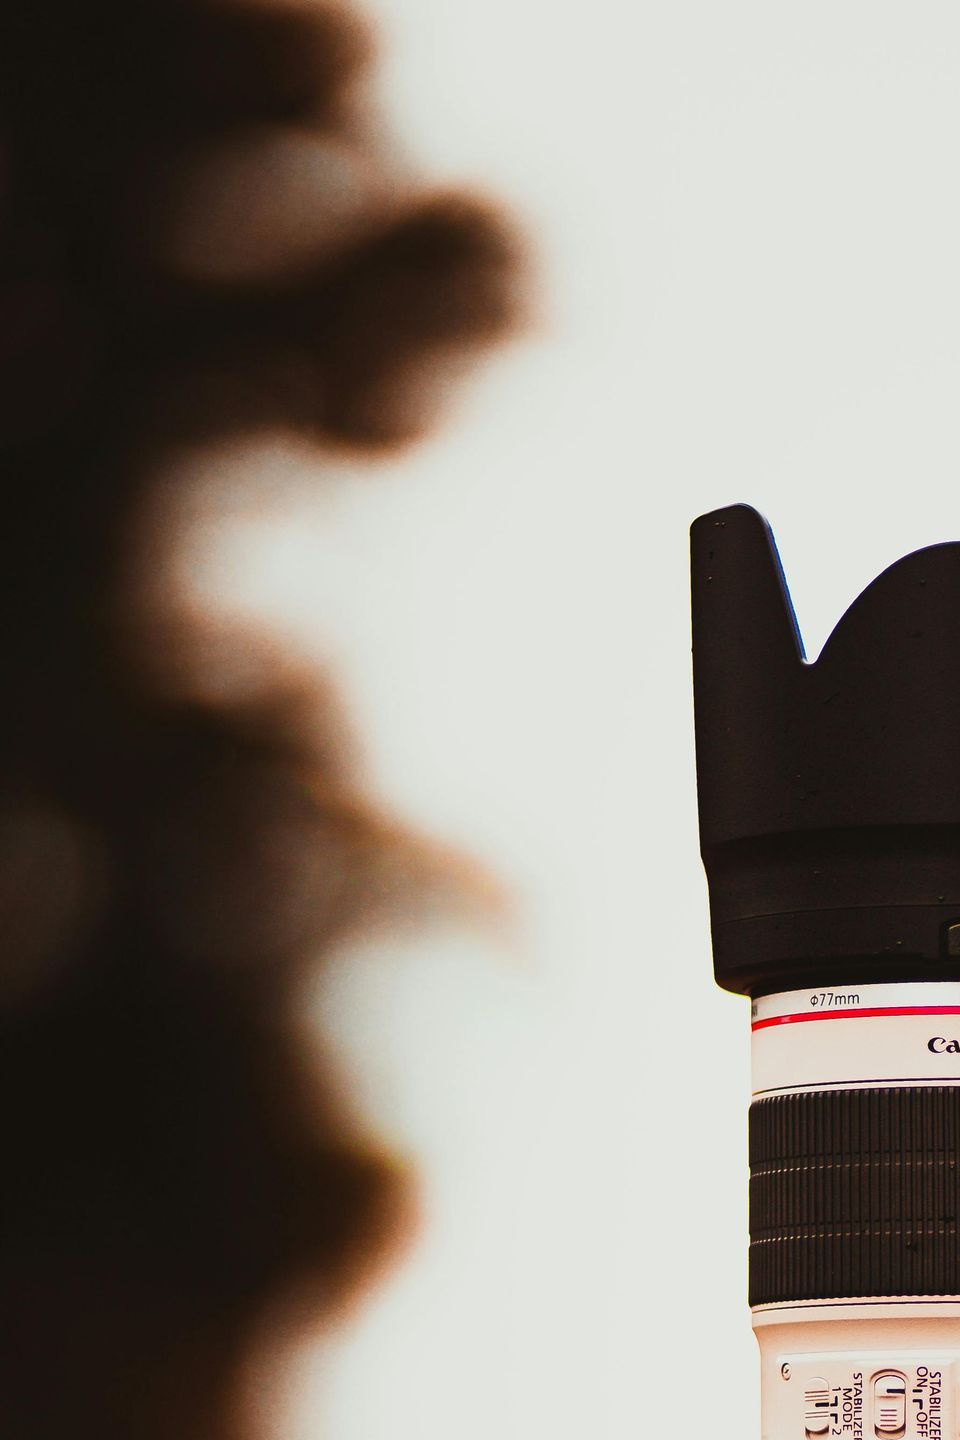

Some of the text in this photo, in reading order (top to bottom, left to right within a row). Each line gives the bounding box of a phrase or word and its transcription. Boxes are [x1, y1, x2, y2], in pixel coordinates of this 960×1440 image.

[916, 1366, 928, 1388] ON
[842, 1387, 852, 1431] MODE
[832, 1428, 842, 1436] 2
[916, 1411, 928, 1438] OFF
